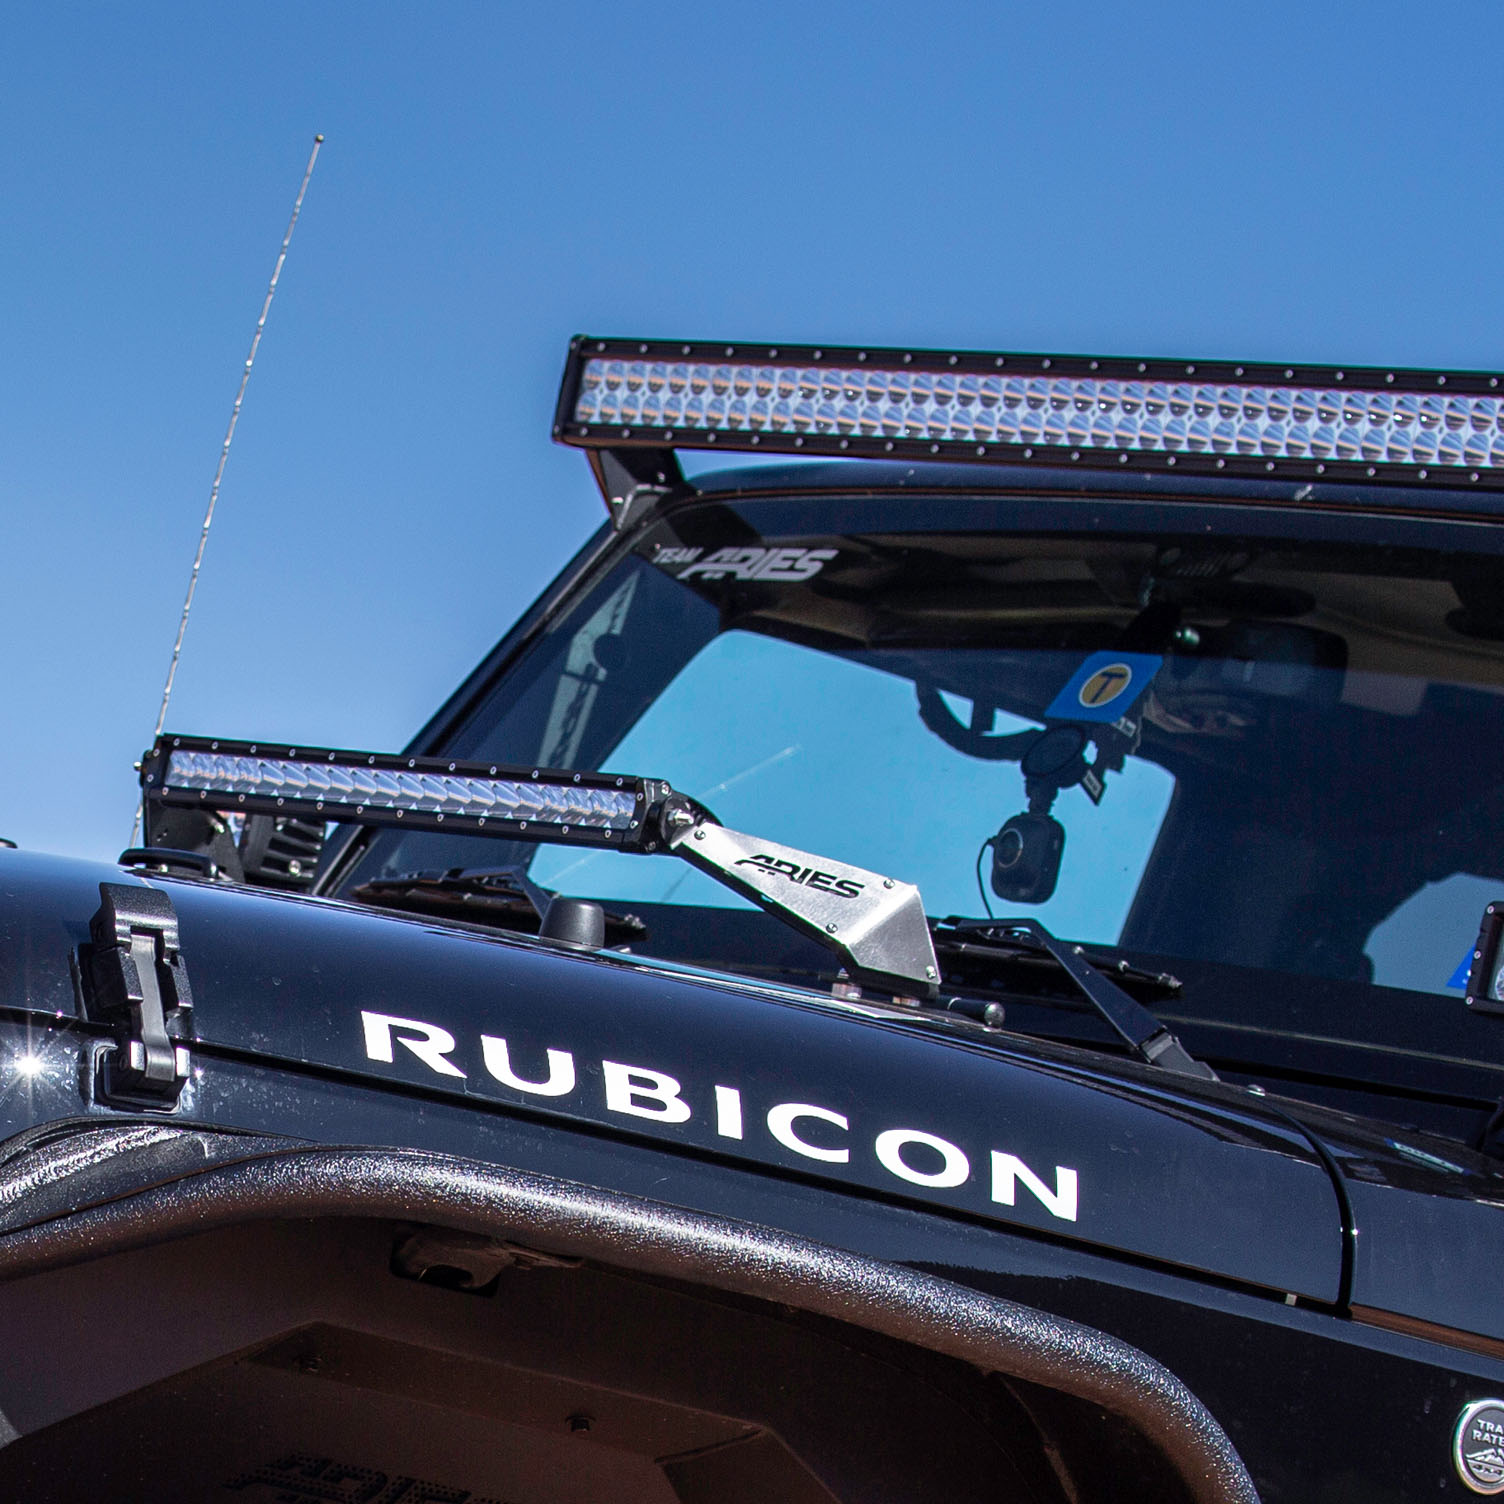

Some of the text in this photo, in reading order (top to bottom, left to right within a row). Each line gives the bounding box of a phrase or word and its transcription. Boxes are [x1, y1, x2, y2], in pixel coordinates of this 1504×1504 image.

[652, 547, 839, 582] TEAM ARIES
[733, 853, 866, 899] ARIES
[360, 1010, 1079, 1223] RUBICON
